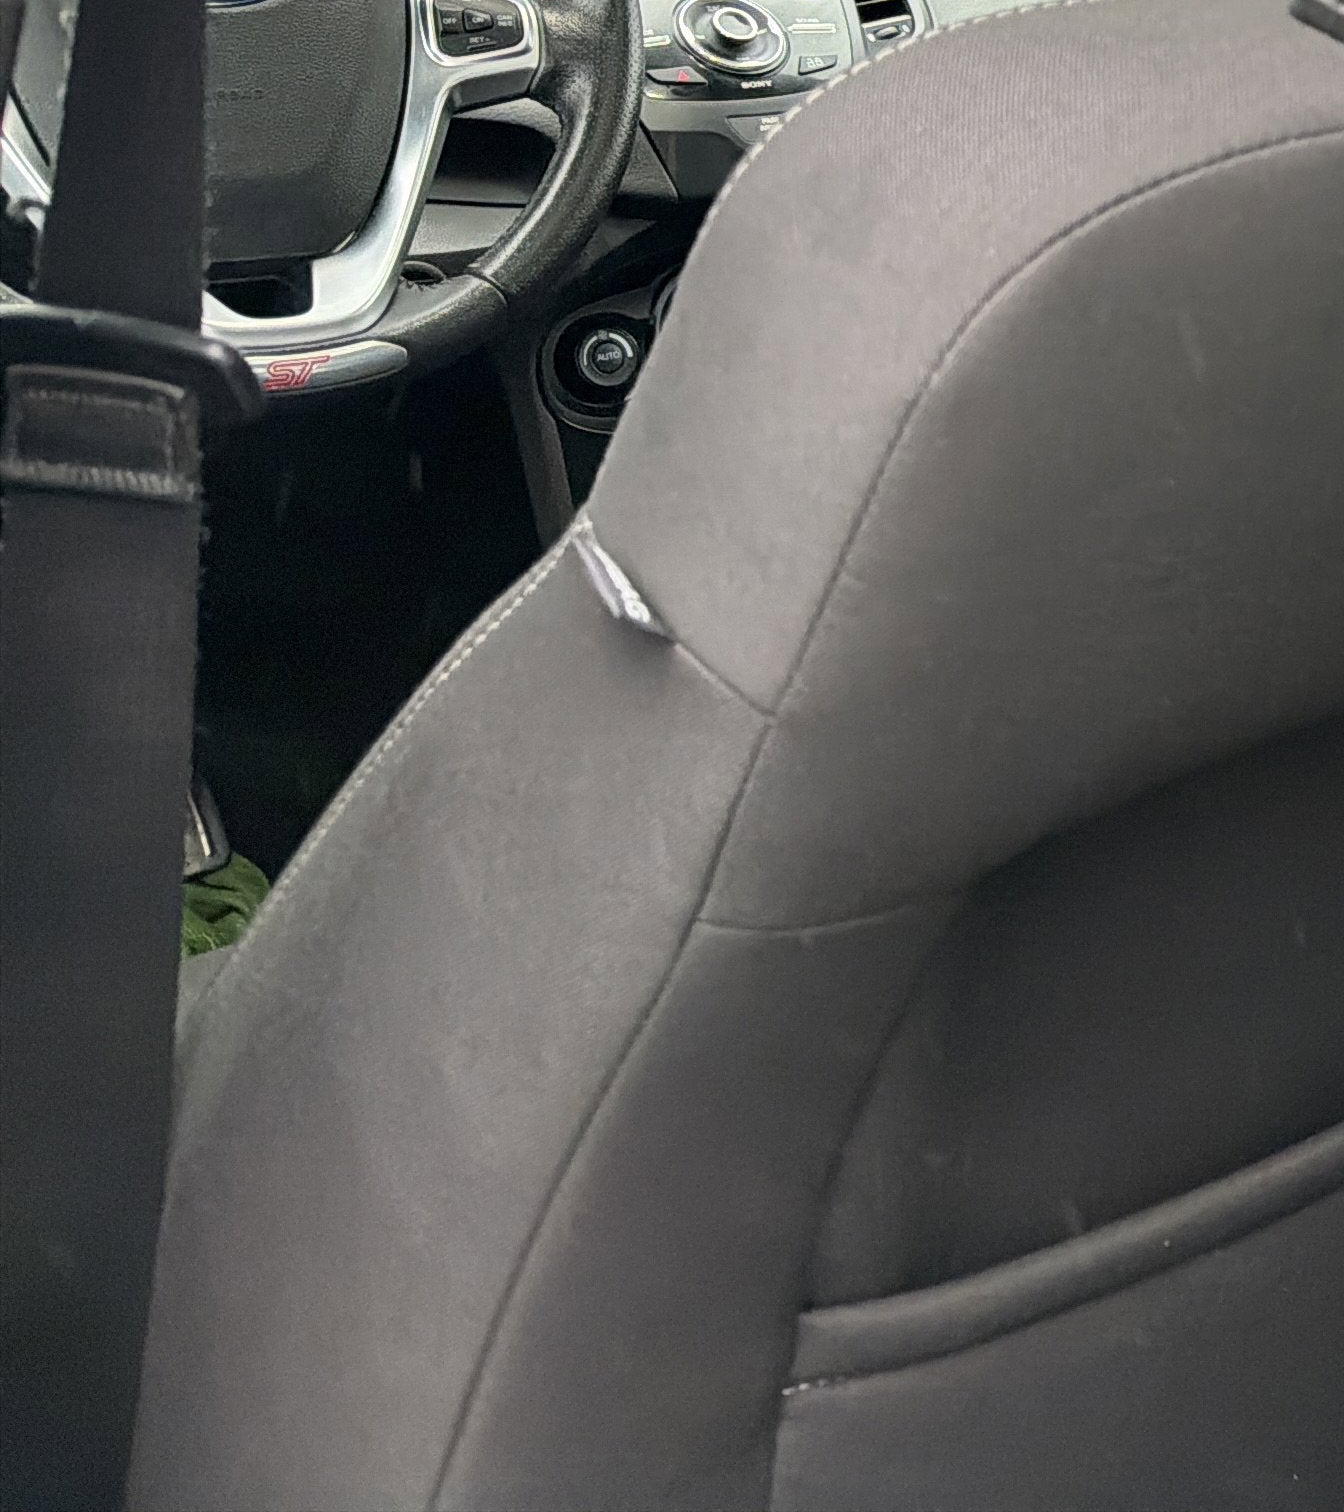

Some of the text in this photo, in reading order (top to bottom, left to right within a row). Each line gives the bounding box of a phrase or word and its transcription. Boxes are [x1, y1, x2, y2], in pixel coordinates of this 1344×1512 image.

[442, 17, 457, 25] OFF
[471, 16, 485, 24] ON
[741, 79, 772, 89] SONY
[596, 350, 621, 362] AUTO
[262, 354, 331, 393] ST
